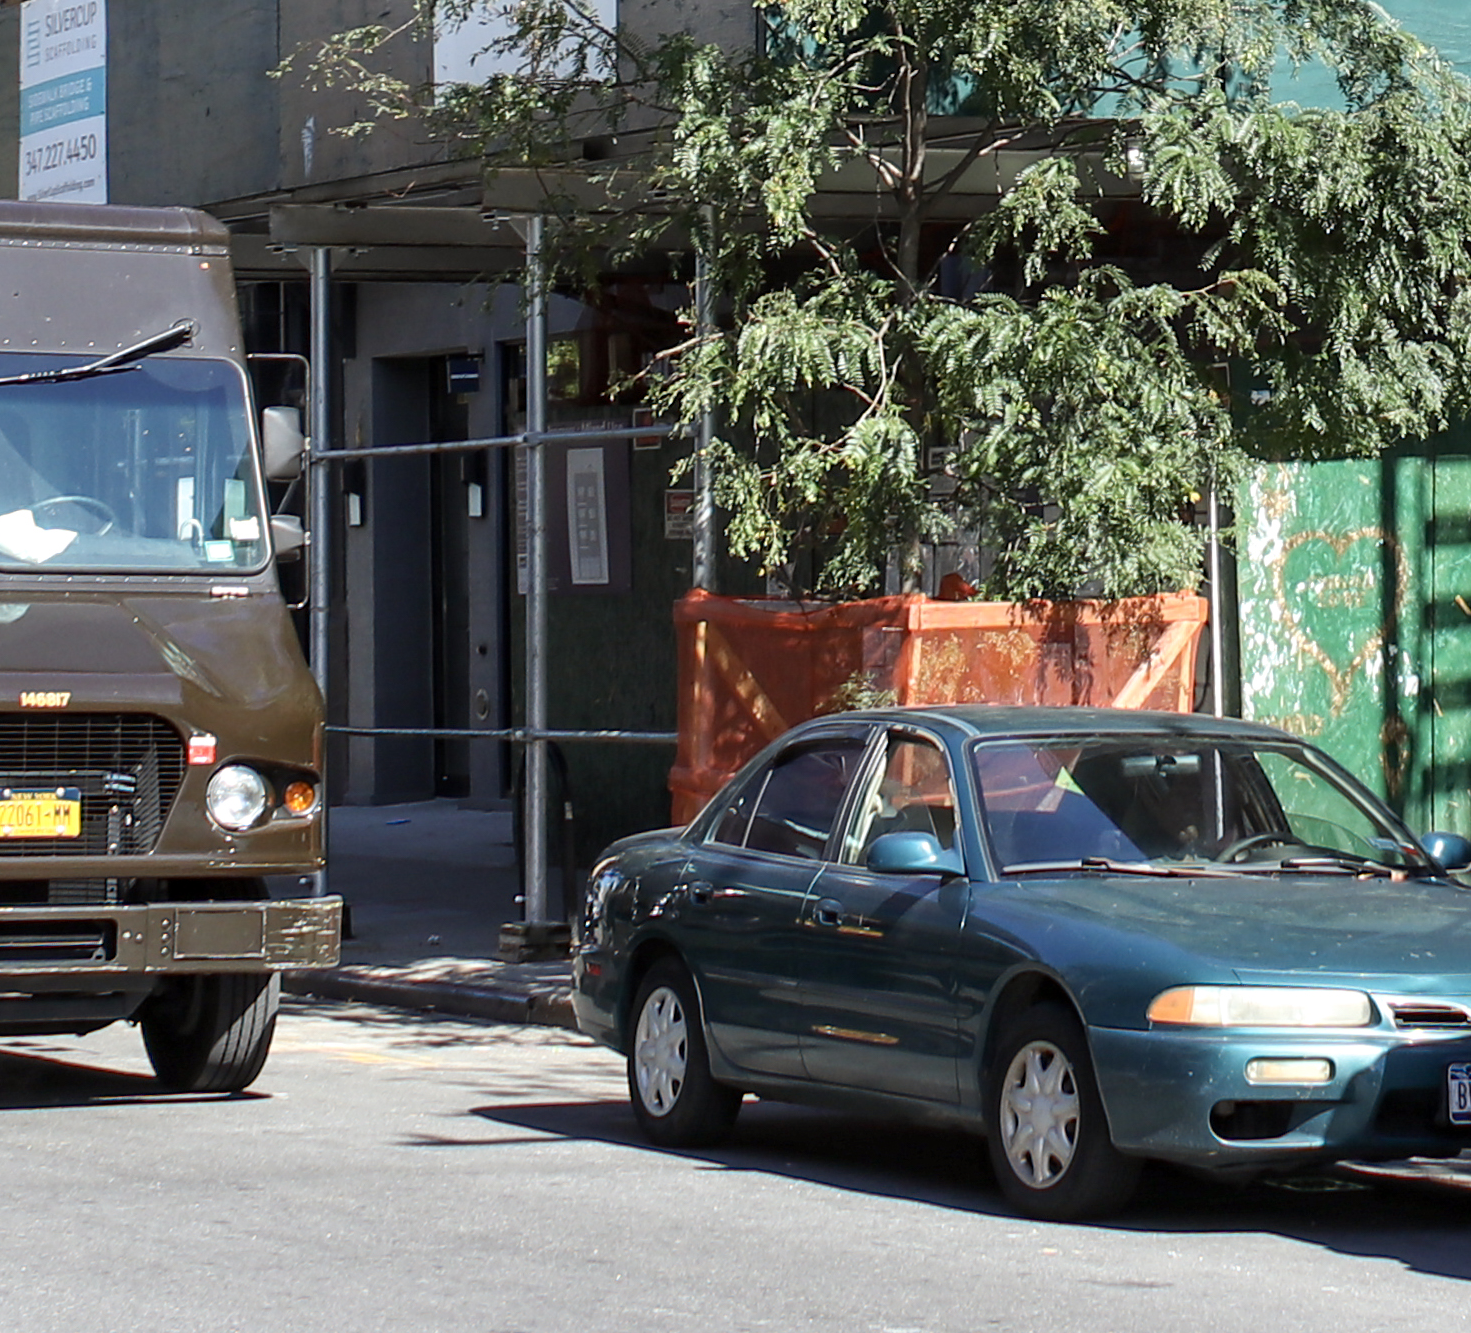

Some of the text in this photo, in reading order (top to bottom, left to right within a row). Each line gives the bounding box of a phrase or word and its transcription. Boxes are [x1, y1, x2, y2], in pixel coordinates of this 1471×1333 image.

[44, 0, 98, 38] SILVERCUP
[44, 34, 98, 63] SCAFFOLDING
[25, 133, 97, 177] 347.227.4450
[19, 691, 71, 708] 146817
